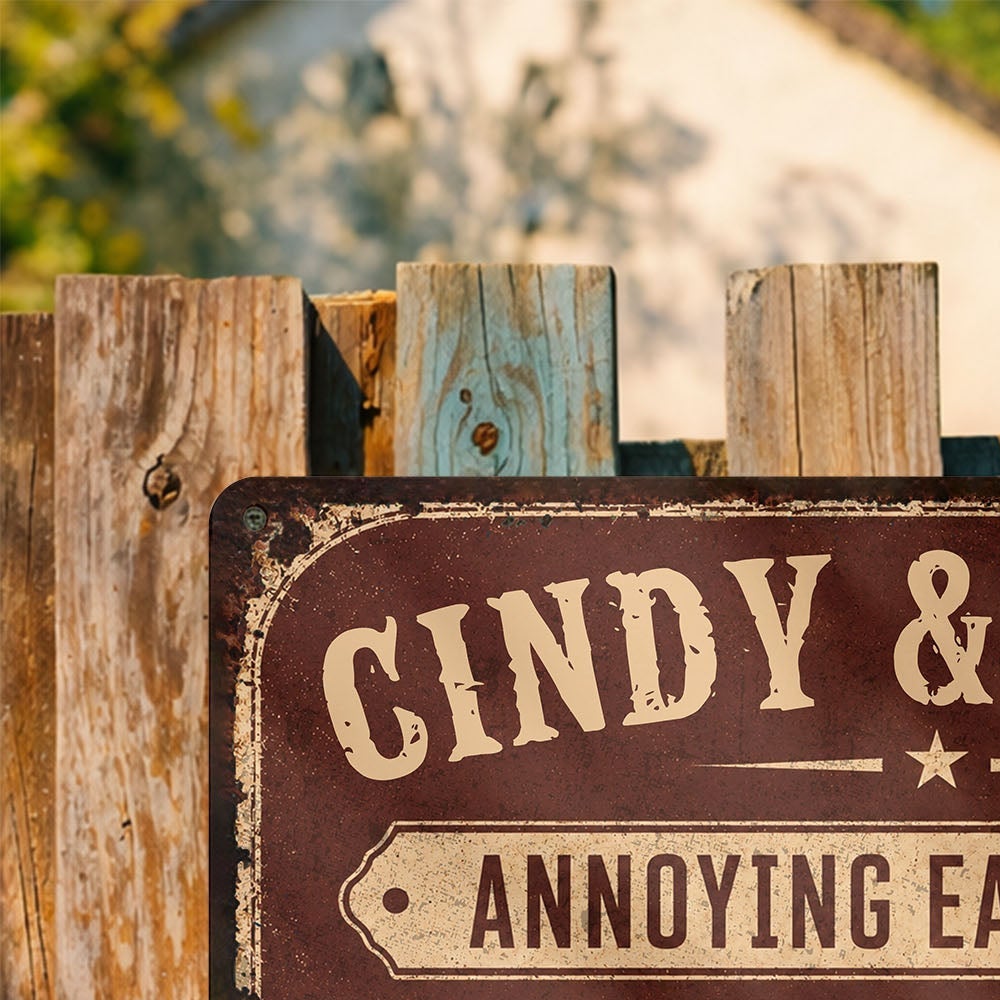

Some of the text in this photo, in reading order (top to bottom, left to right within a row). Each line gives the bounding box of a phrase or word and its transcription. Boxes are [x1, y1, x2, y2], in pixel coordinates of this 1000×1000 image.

[323, 554, 832, 781] CINDY
[893, 550, 994, 706] &
[469, 853, 891, 949] ANNOYING
